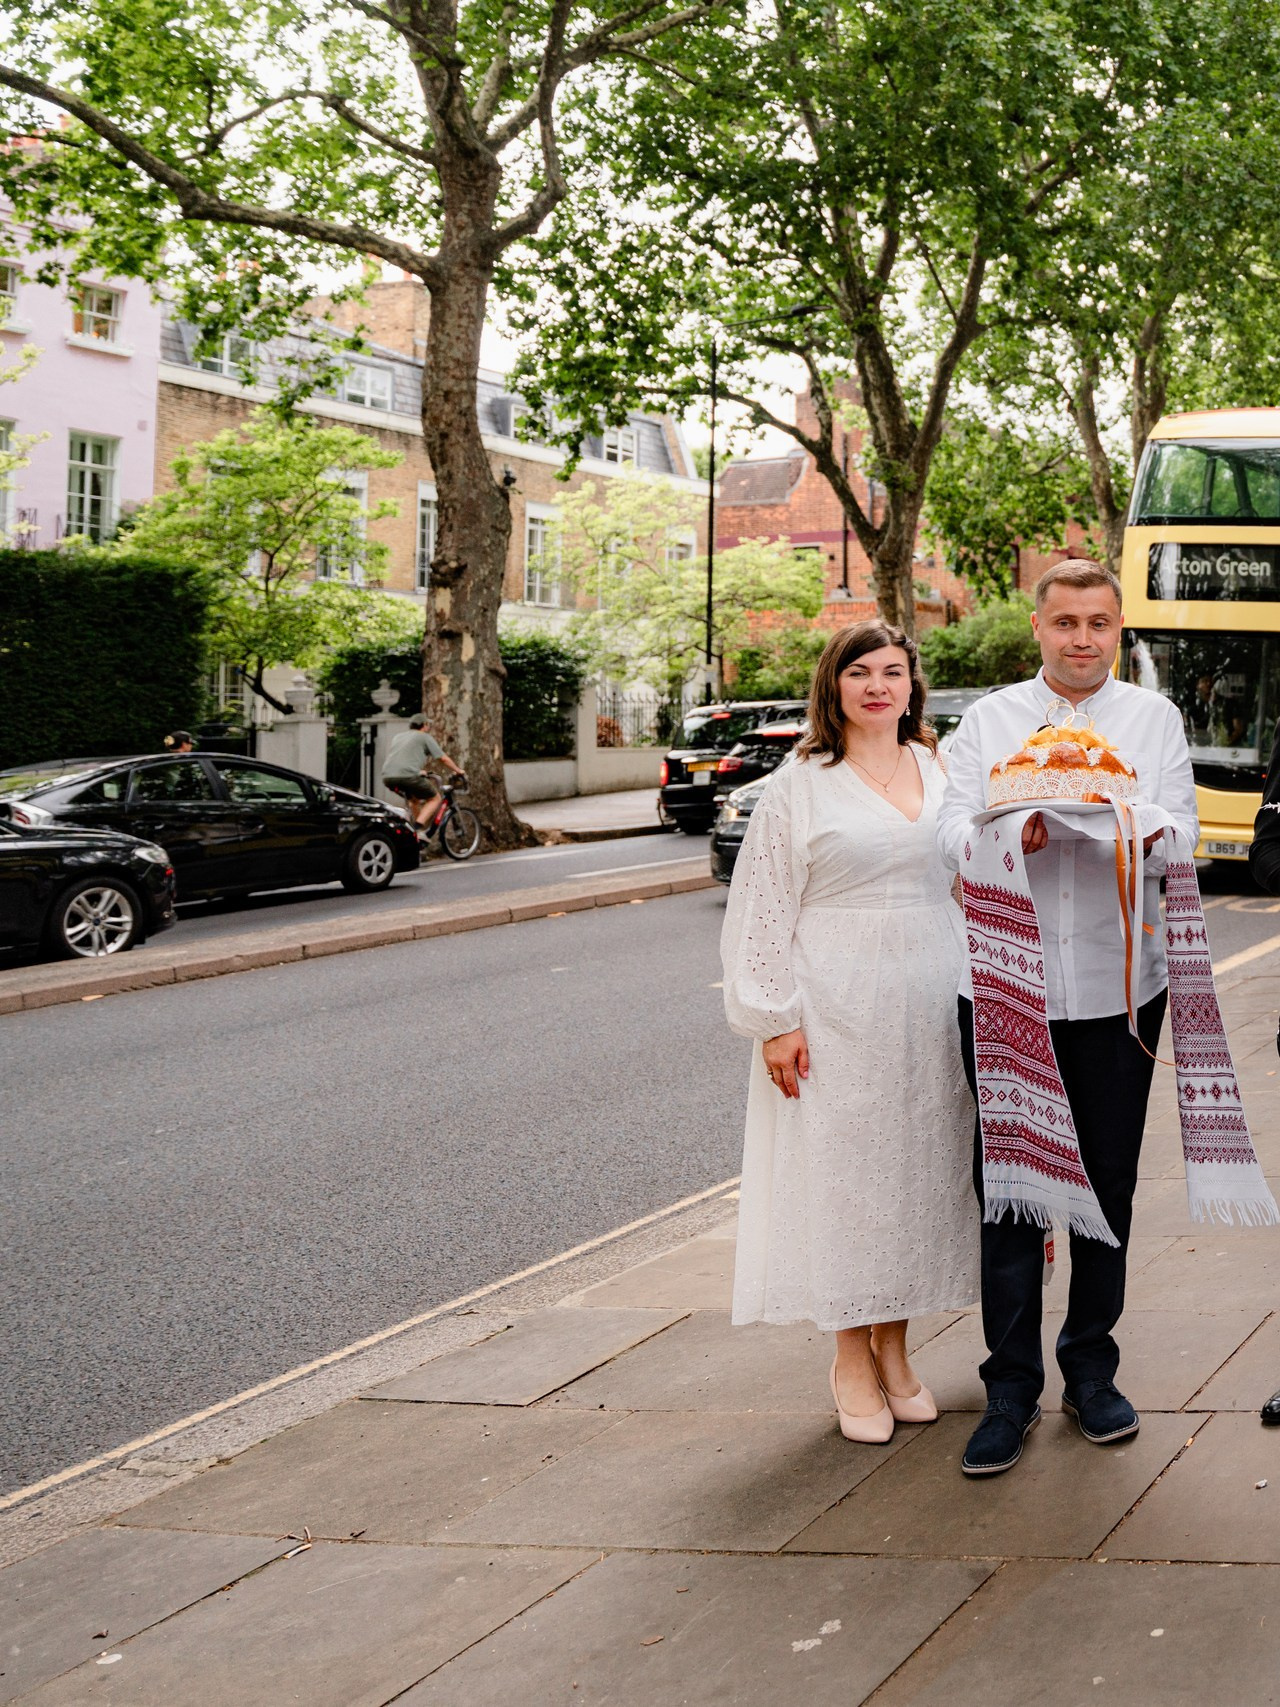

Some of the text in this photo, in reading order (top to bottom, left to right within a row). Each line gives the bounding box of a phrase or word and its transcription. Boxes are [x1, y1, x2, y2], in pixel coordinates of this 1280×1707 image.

[1160, 556, 1271, 577] Acton Green
[1208, 843, 1236, 854] LB69
